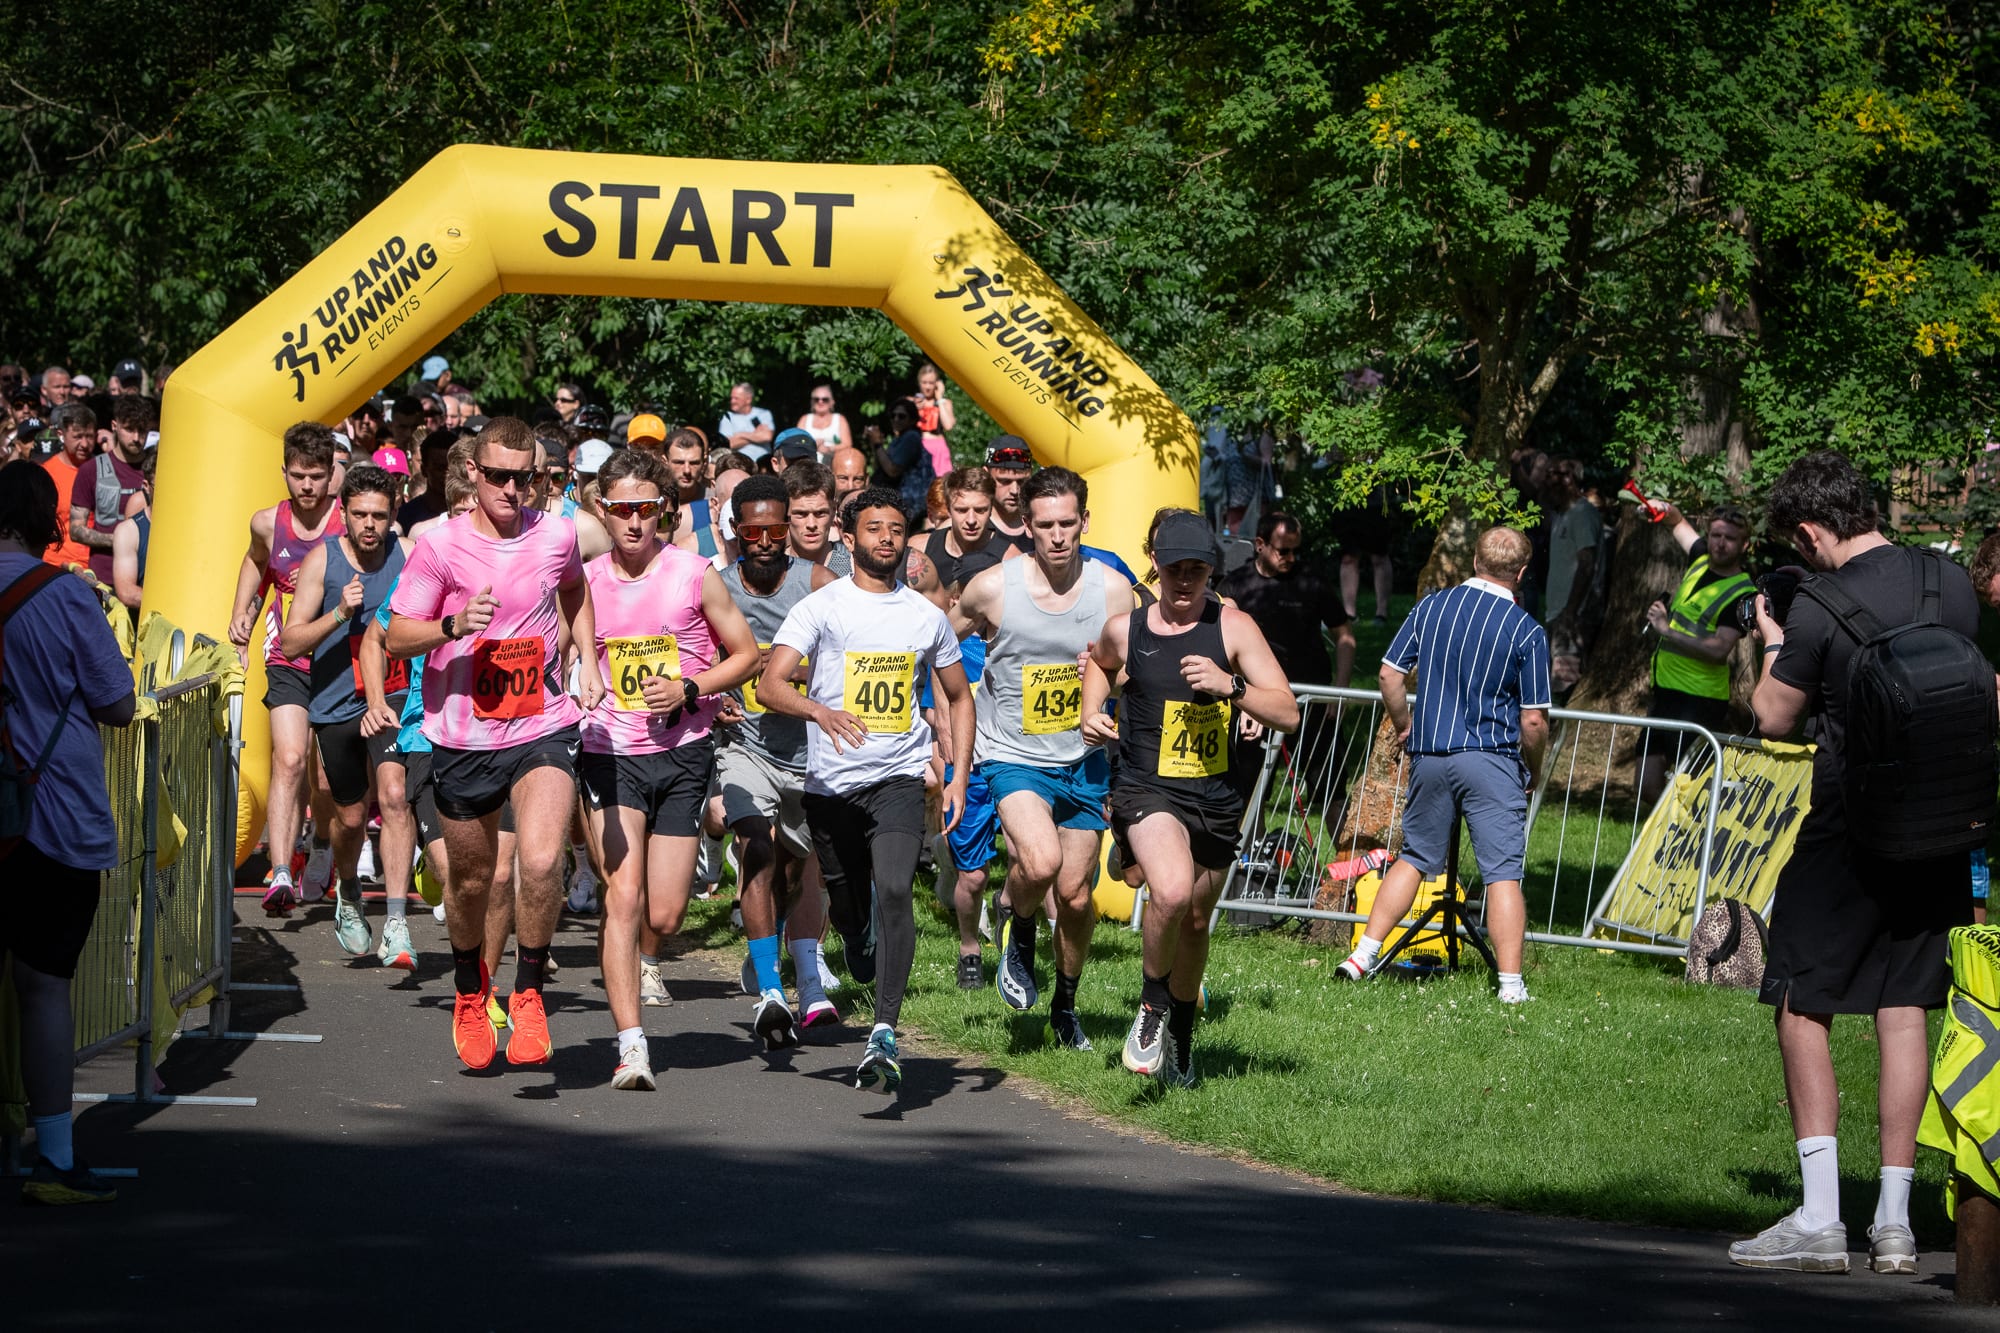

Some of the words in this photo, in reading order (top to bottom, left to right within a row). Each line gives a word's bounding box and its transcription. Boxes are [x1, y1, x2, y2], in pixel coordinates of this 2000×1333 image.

[542, 181, 855, 268] START
[314, 286, 350, 329] UP
[352, 236, 406, 299] AND
[320, 242, 438, 364] RUNNING
[367, 294, 421, 350] EVENTS
[1010, 302, 1054, 336] UP
[1043, 335, 1109, 387] AND
[976, 311, 1105, 418] RUNNING
[992, 355, 1052, 405] EVENTS
[496, 647, 538, 661] RUNNING
[514, 640, 534, 649] AND
[628, 644, 670, 657] RUNNING
[643, 638, 665, 647] AND
[868, 663, 910, 673] RUNNING
[885, 655, 906, 664] AND
[1048, 668, 1061, 676] UP
[477, 666, 539, 697] 6002
[1044, 673, 1079, 684] RUNNIN
[855, 680, 905, 714] 405
[1033, 686, 1081, 718] 434
[1186, 711, 1225, 725] RUNNING
[1171, 728, 1219, 762] 448
